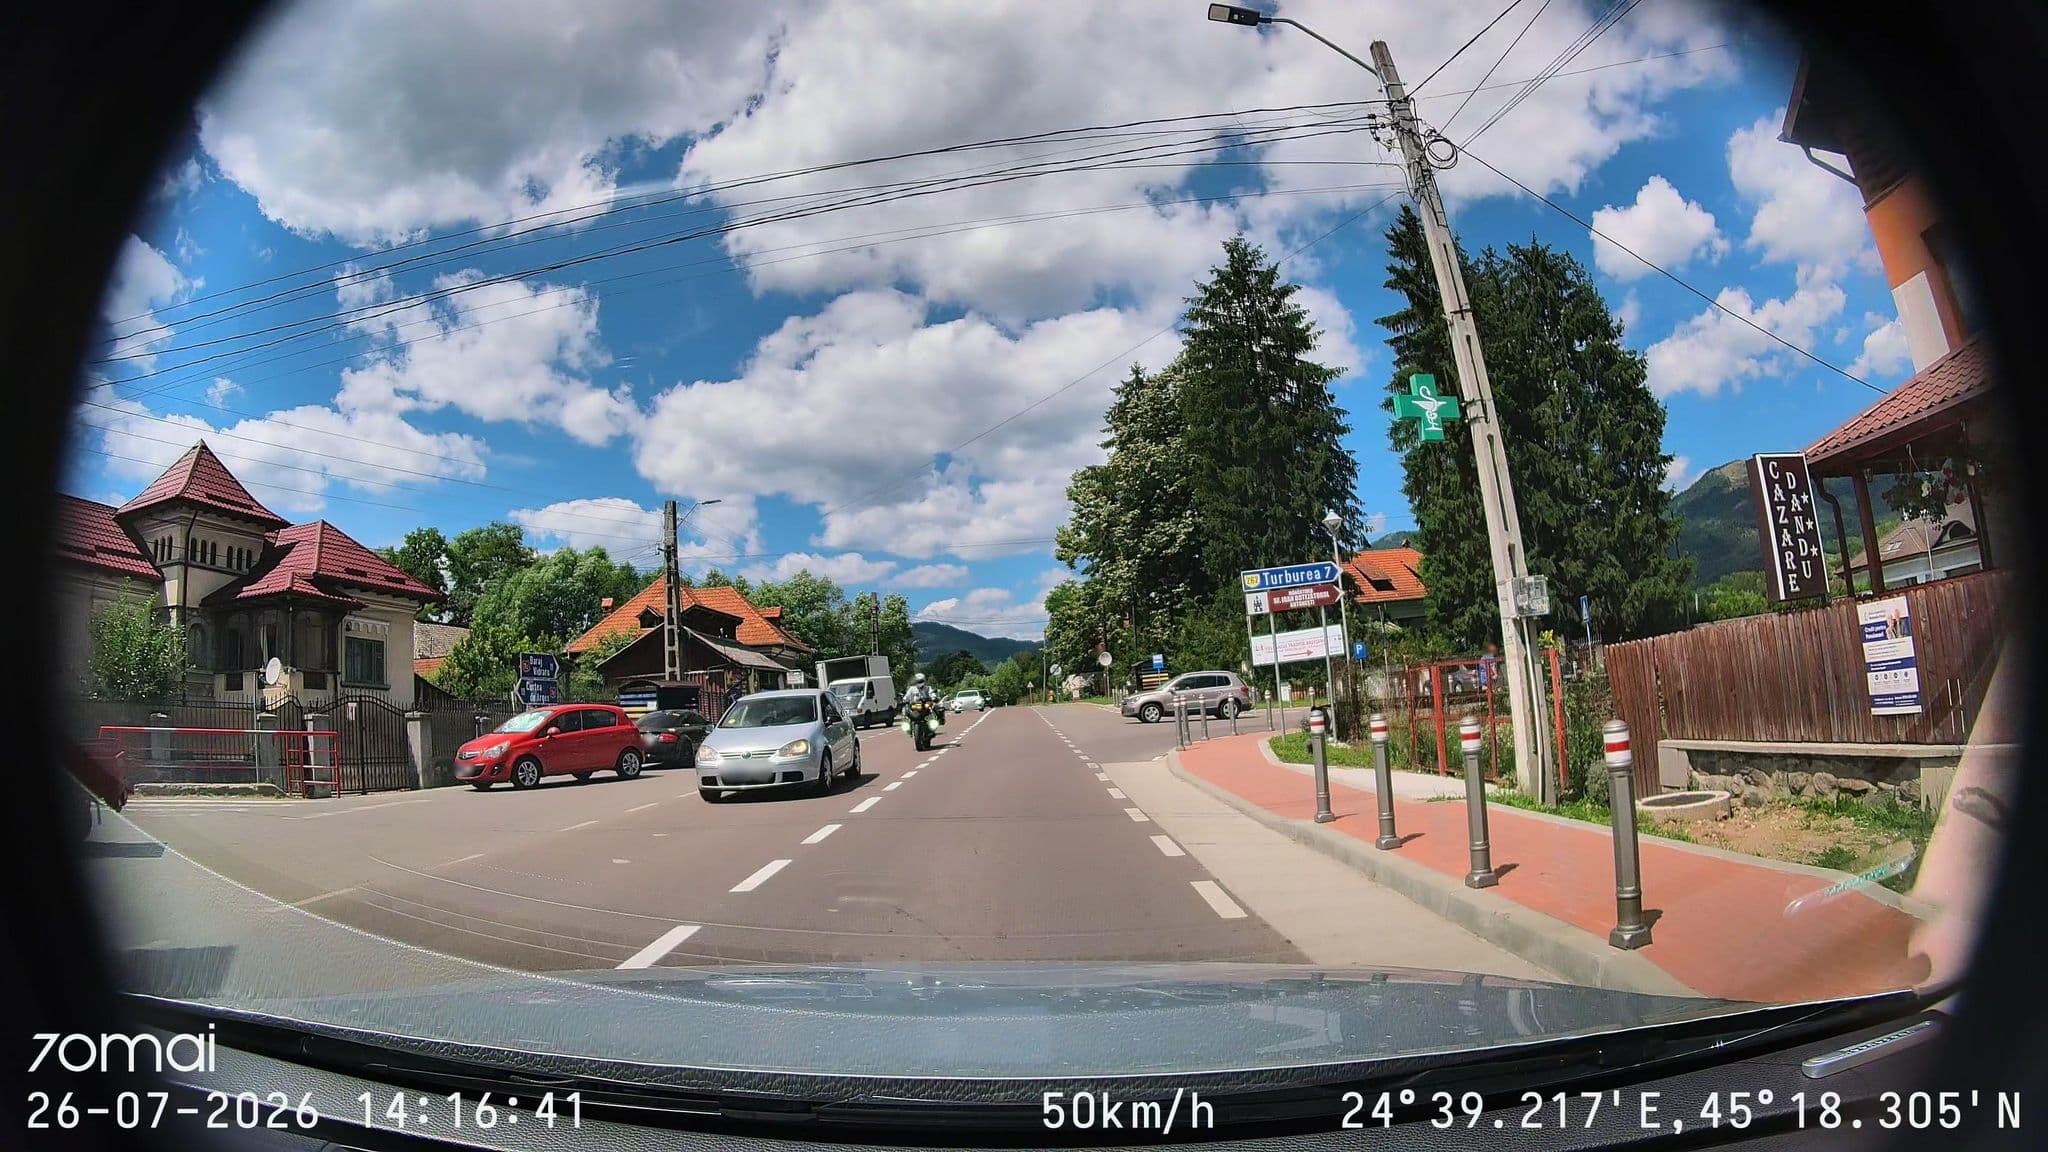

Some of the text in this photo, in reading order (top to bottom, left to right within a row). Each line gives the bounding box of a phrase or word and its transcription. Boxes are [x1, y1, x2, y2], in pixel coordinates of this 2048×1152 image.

[1768, 461, 1800, 593] CAZARE
[1786, 471, 1812, 580] DANDU
[1262, 569, 1321, 586] Turburea
[1323, 566, 1332, 579] 7
[1356, 644, 1363, 654] P
